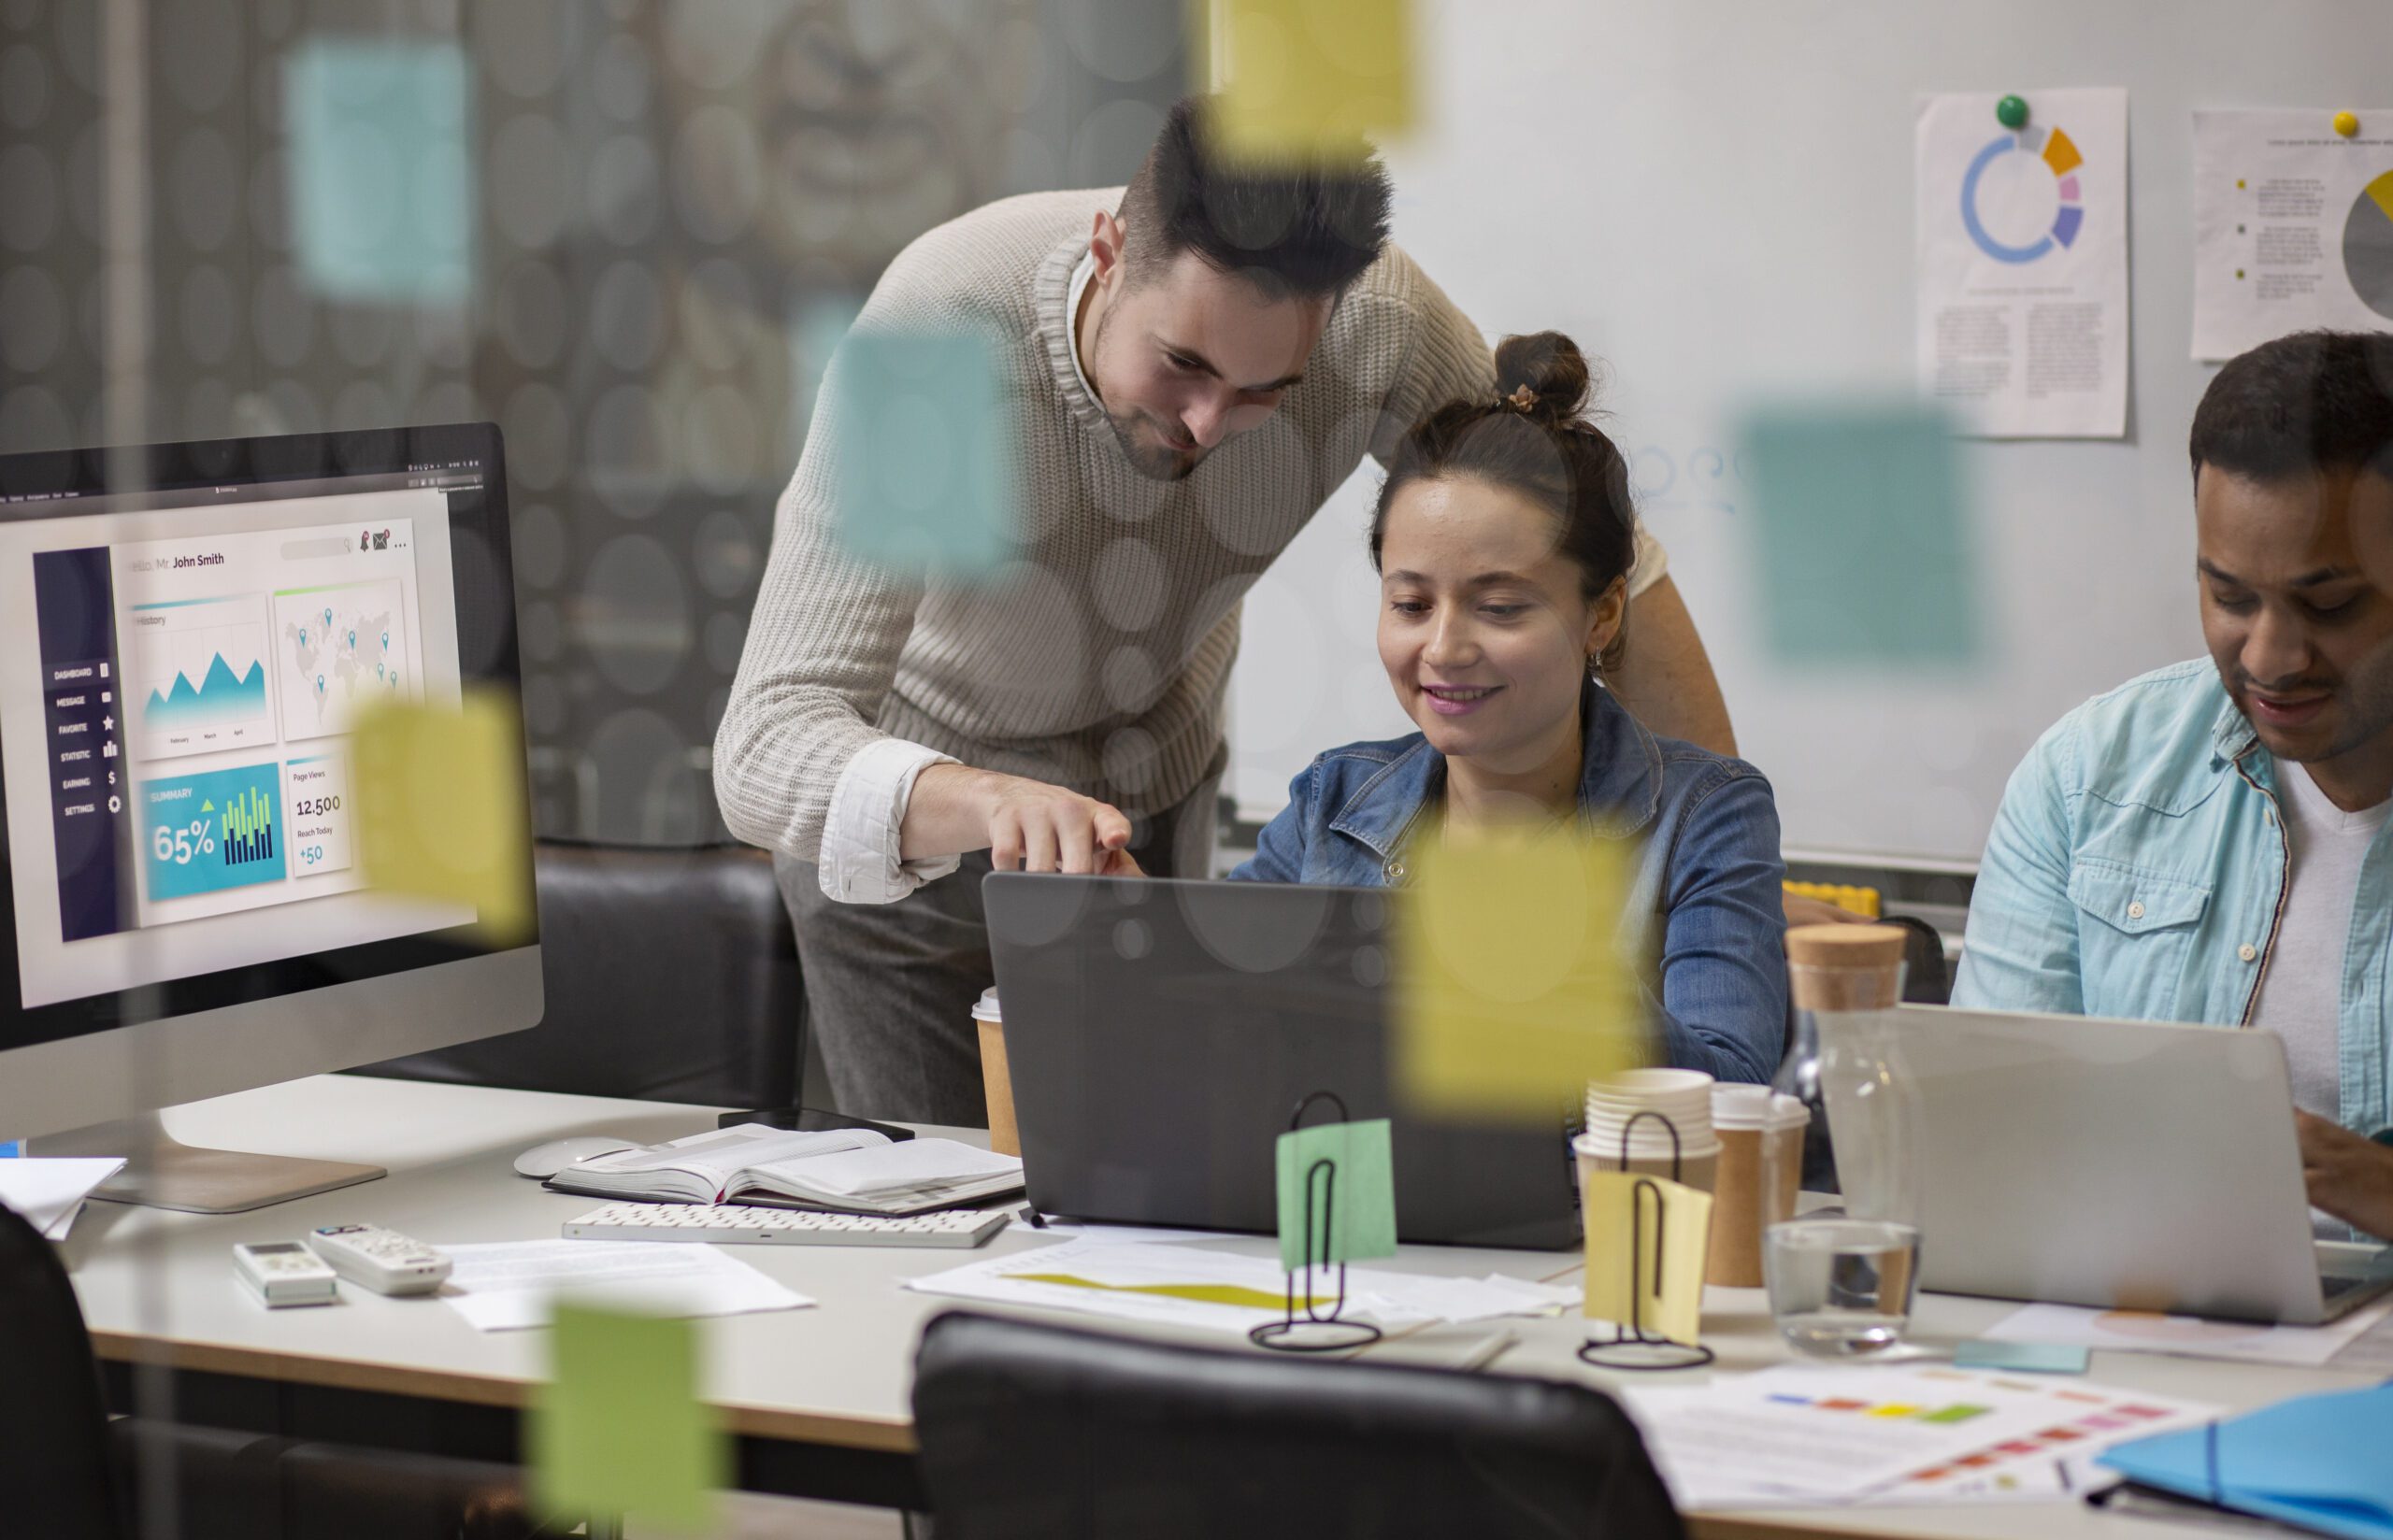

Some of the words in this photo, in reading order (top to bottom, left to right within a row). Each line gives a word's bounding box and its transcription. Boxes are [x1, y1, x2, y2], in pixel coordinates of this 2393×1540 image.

[173, 556, 195, 569] John
[197, 553, 224, 566] Smith
[136, 616, 165, 626] History
[54, 667, 92, 680] DASHBOARD
[56, 695, 85, 707] MESSAGE
[58, 722, 88, 734] FAVORITE
[61, 749, 91, 763] STATISTIC
[293, 773, 308, 782] Page
[308, 770, 325, 779] Views
[150, 787, 193, 802] SUMMARY
[64, 804, 95, 816] SETTINGS
[296, 795, 341, 816] 12.500
[297, 828, 315, 837] Reach
[316, 826, 333, 835] Today
[153, 819, 215, 864] 65%
[300, 845, 322, 864] +50
